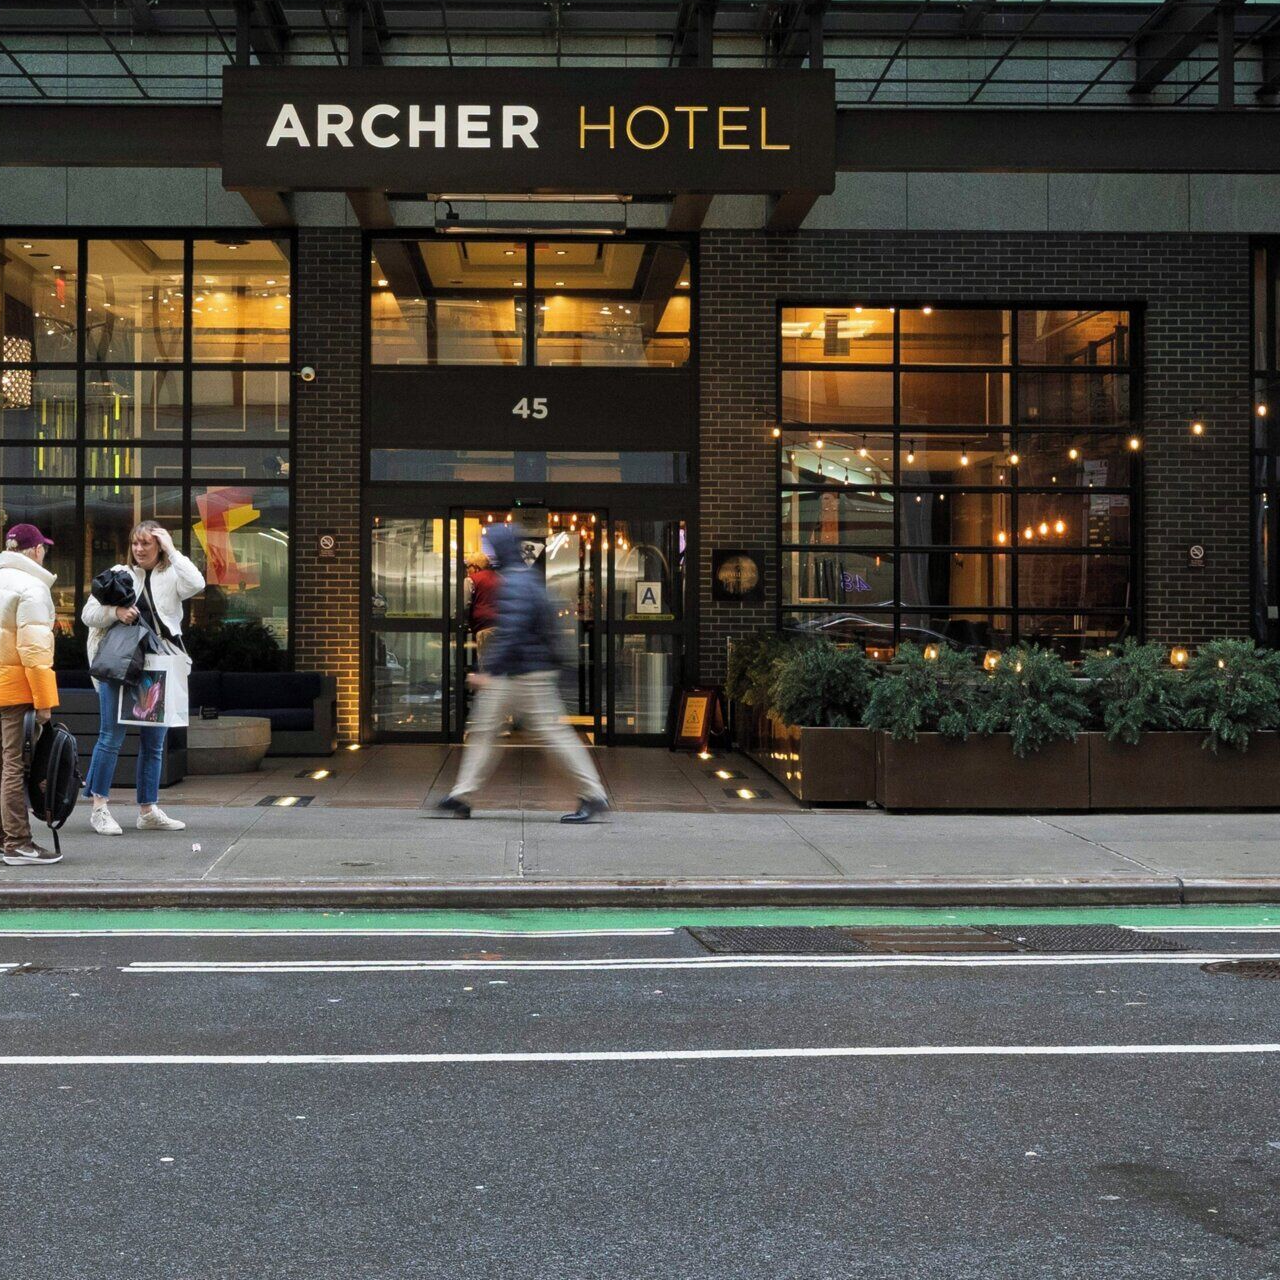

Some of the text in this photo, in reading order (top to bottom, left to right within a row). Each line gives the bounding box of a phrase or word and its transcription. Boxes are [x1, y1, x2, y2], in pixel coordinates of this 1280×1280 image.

[266, 103, 791, 150] ARCHER HOTEL
[512, 397, 548, 419] 45
[640, 586, 657, 605] A
